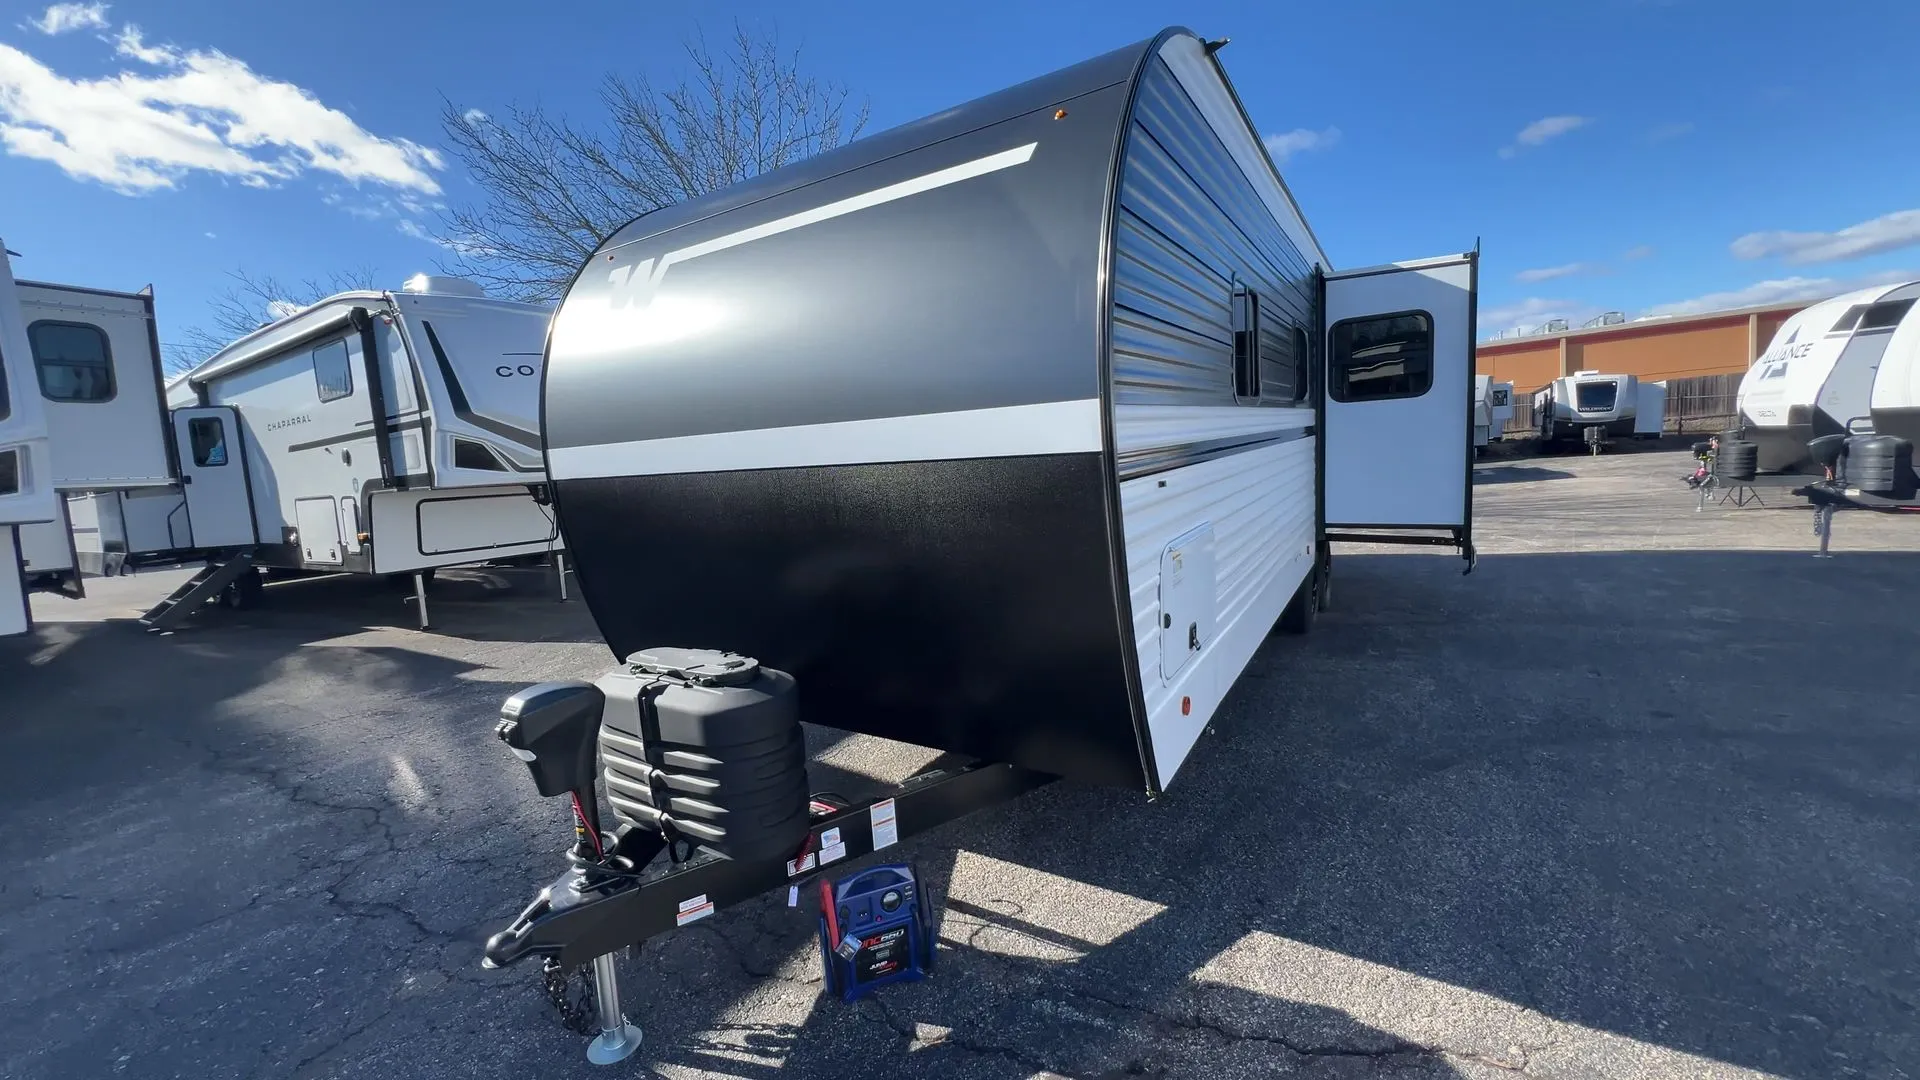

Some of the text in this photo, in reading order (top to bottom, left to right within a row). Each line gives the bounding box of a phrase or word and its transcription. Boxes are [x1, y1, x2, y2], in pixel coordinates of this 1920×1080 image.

[1762, 342, 1815, 364] ALLIANCE
[267, 414, 312, 432] CHAPARRAL
[869, 960, 888, 970] JUMP
